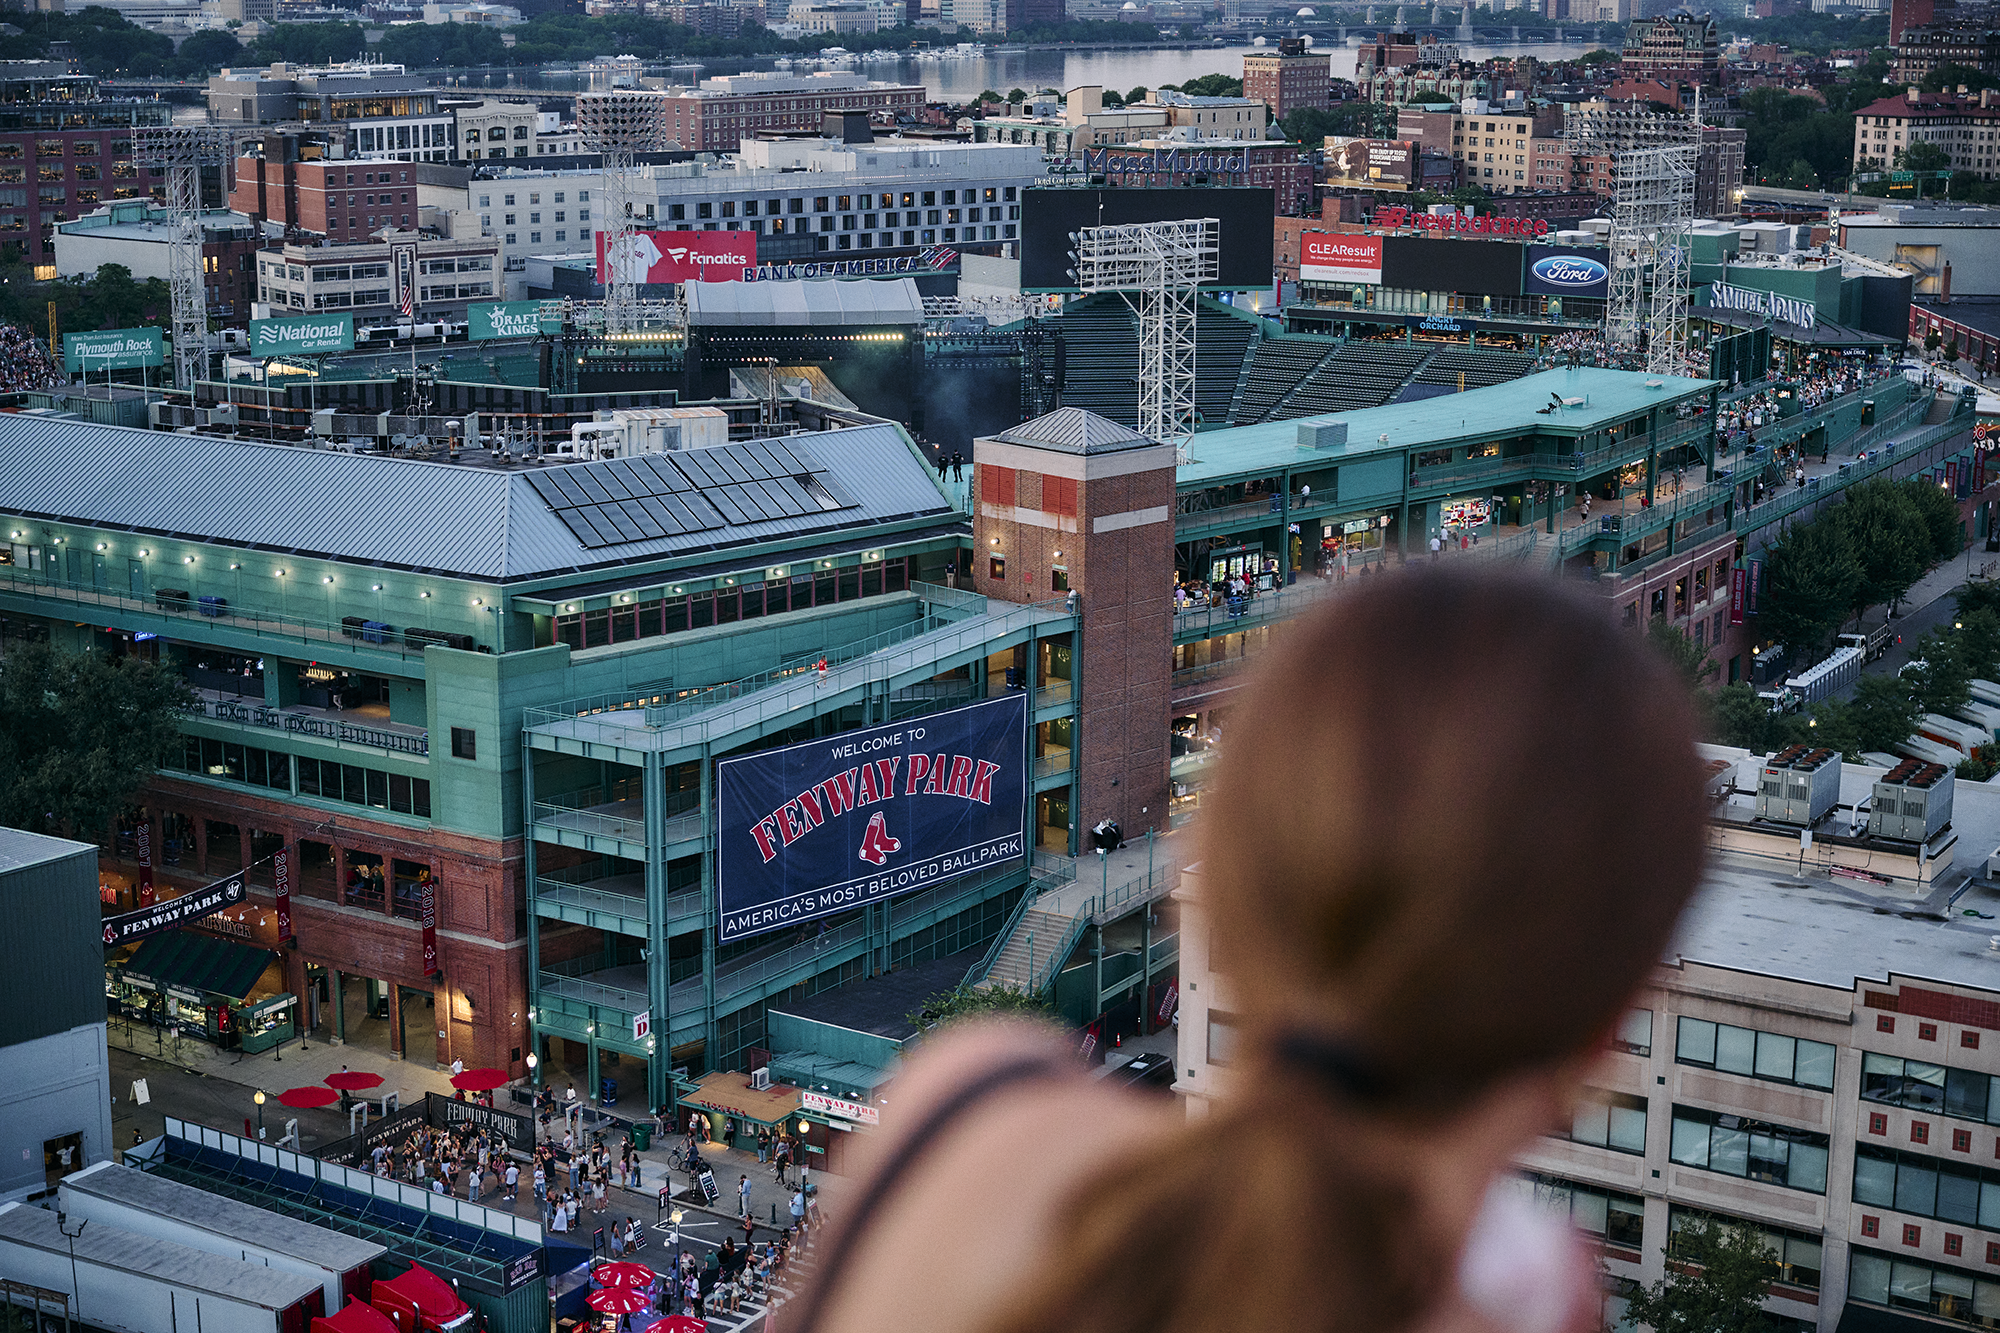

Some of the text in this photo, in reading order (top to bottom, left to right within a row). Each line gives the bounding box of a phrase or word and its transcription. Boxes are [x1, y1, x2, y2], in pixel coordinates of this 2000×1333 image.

[1082, 147, 1250, 174] MassMutual
[1410, 212, 1453, 231] new
[1455, 211, 1548, 235] balance
[690, 251, 747, 266] Fanatics
[1308, 243, 1375, 257] CLEAResult
[743, 256, 919, 283] BANK OF AMERICA
[1546, 260, 1594, 283] Ford
[1709, 280, 1815, 330] SAMUEL ADAMS
[490, 313, 540, 329] DRAFT
[498, 324, 539, 336] KINGS
[1420, 322, 1461, 332] ORCHARD
[1426, 316, 1454, 324] ANGRY
[278, 321, 344, 342] National
[74, 338, 152, 356] Plymouth Rock
[302, 338, 342, 348] Car Rental
[831, 727, 926, 761] WELCOME TO
[749, 753, 1001, 864] FENWAY PARK
[138, 823, 151, 868] 2007
[274, 853, 289, 897] 2013
[726, 838, 1020, 933] AMERICA'S MOST BELOVED BALLPARK
[122, 891, 223, 936] FENWAY PARK
[152, 895, 193, 914] WELCOME TO
[422, 884, 435, 928] 2018
[635, 1014, 647, 1022] GATE
[637, 1021, 648, 1037] D
[699, 1100, 747, 1117] TICKETS
[804, 1093, 846, 1109] FENWAY
[848, 1104, 876, 1116] PARK
[367, 1116, 423, 1146] FENWAY PARK
[447, 1102, 518, 1139] FENWAY PARK
[515, 1254, 532, 1266] OFFICIAL
[510, 1267, 538, 1287] MERCHANDISE
